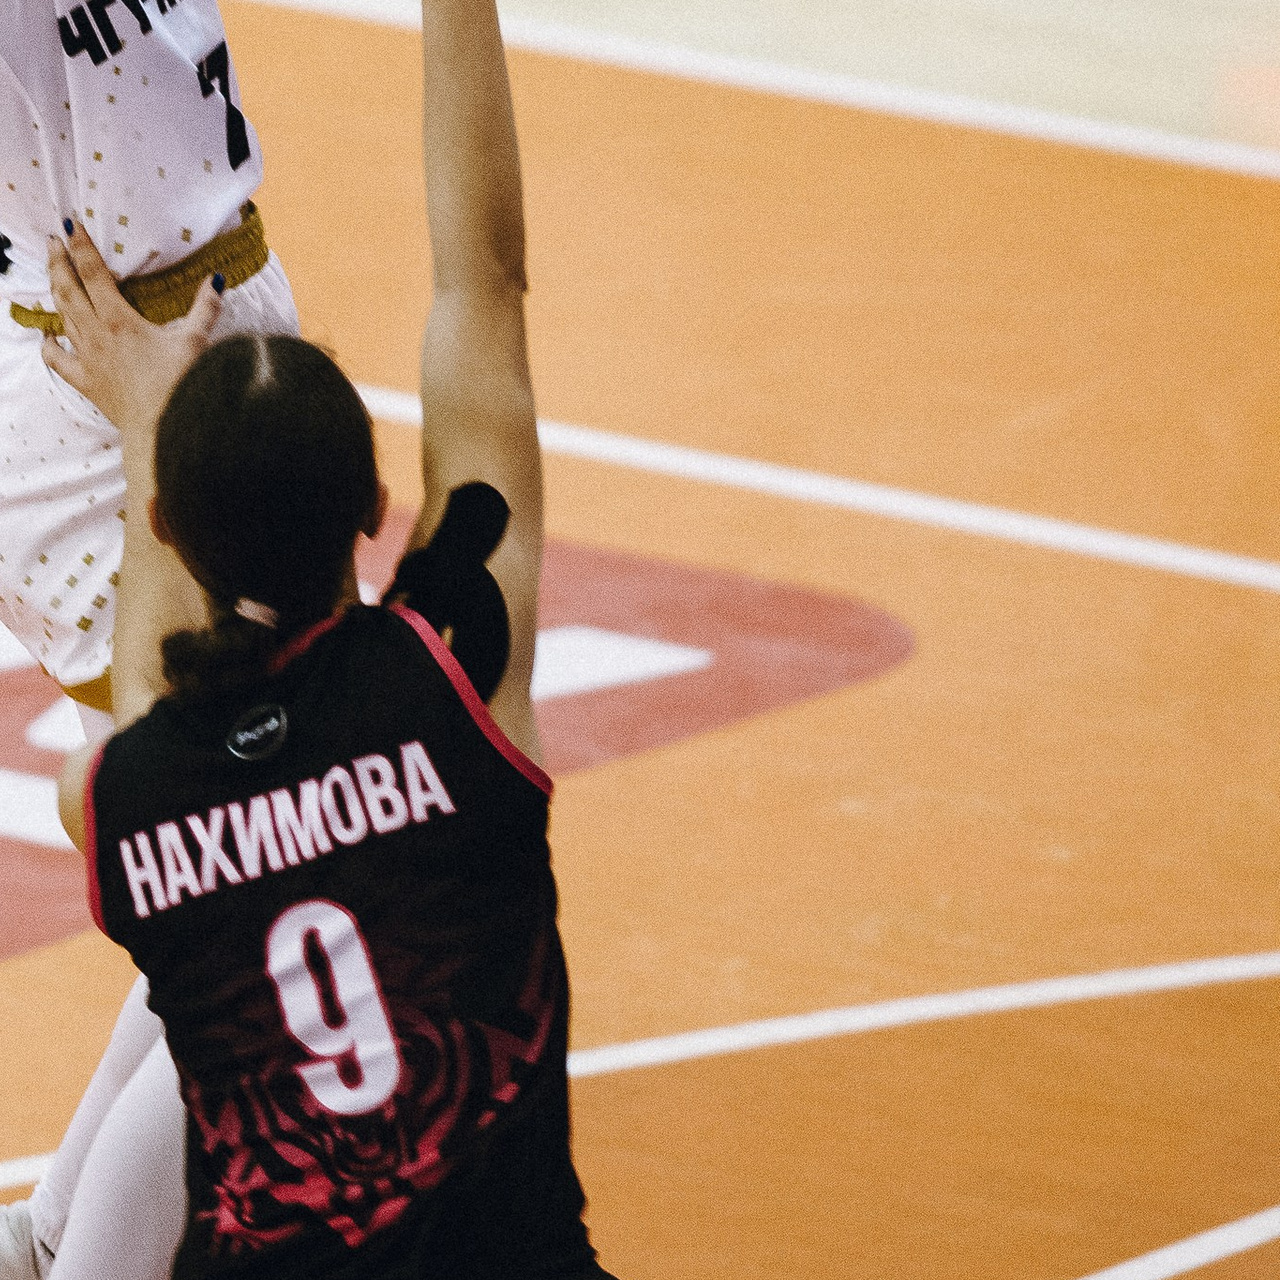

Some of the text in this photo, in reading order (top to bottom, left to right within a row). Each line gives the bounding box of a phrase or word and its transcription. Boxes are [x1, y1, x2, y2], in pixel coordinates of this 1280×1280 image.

[195, 40, 252, 171] 7
[120, 740, 456, 919] НАХИМОВА
[266, 898, 402, 1116] 9
